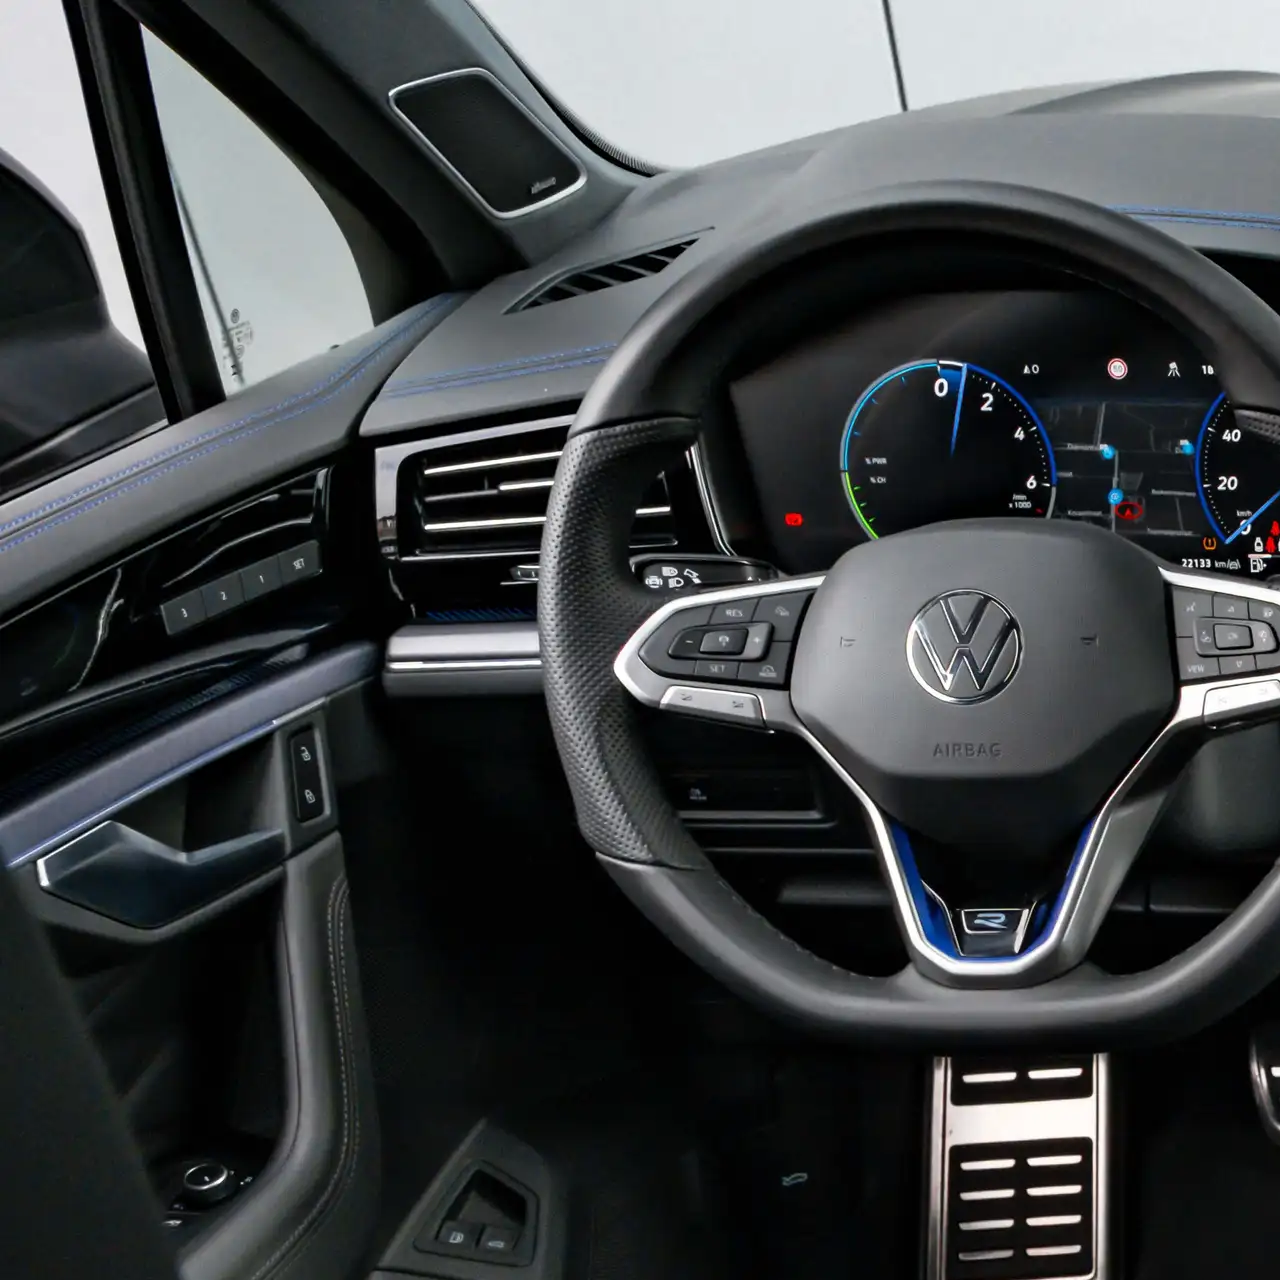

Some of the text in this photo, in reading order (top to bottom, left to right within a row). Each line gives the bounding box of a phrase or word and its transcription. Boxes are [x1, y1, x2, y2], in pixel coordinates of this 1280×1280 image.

[934, 379, 949, 397] 0
[981, 393, 993, 411] 2
[1014, 427, 1024, 440] 4
[1222, 429, 1241, 442] 40
[1027, 476, 1036, 489] 6
[1218, 476, 1238, 490] 20
[1182, 559, 1211, 568] 22133
[725, 608, 744, 619] RES
[708, 664, 726, 675] SET
[933, 743, 1002, 757] AIRBAG
